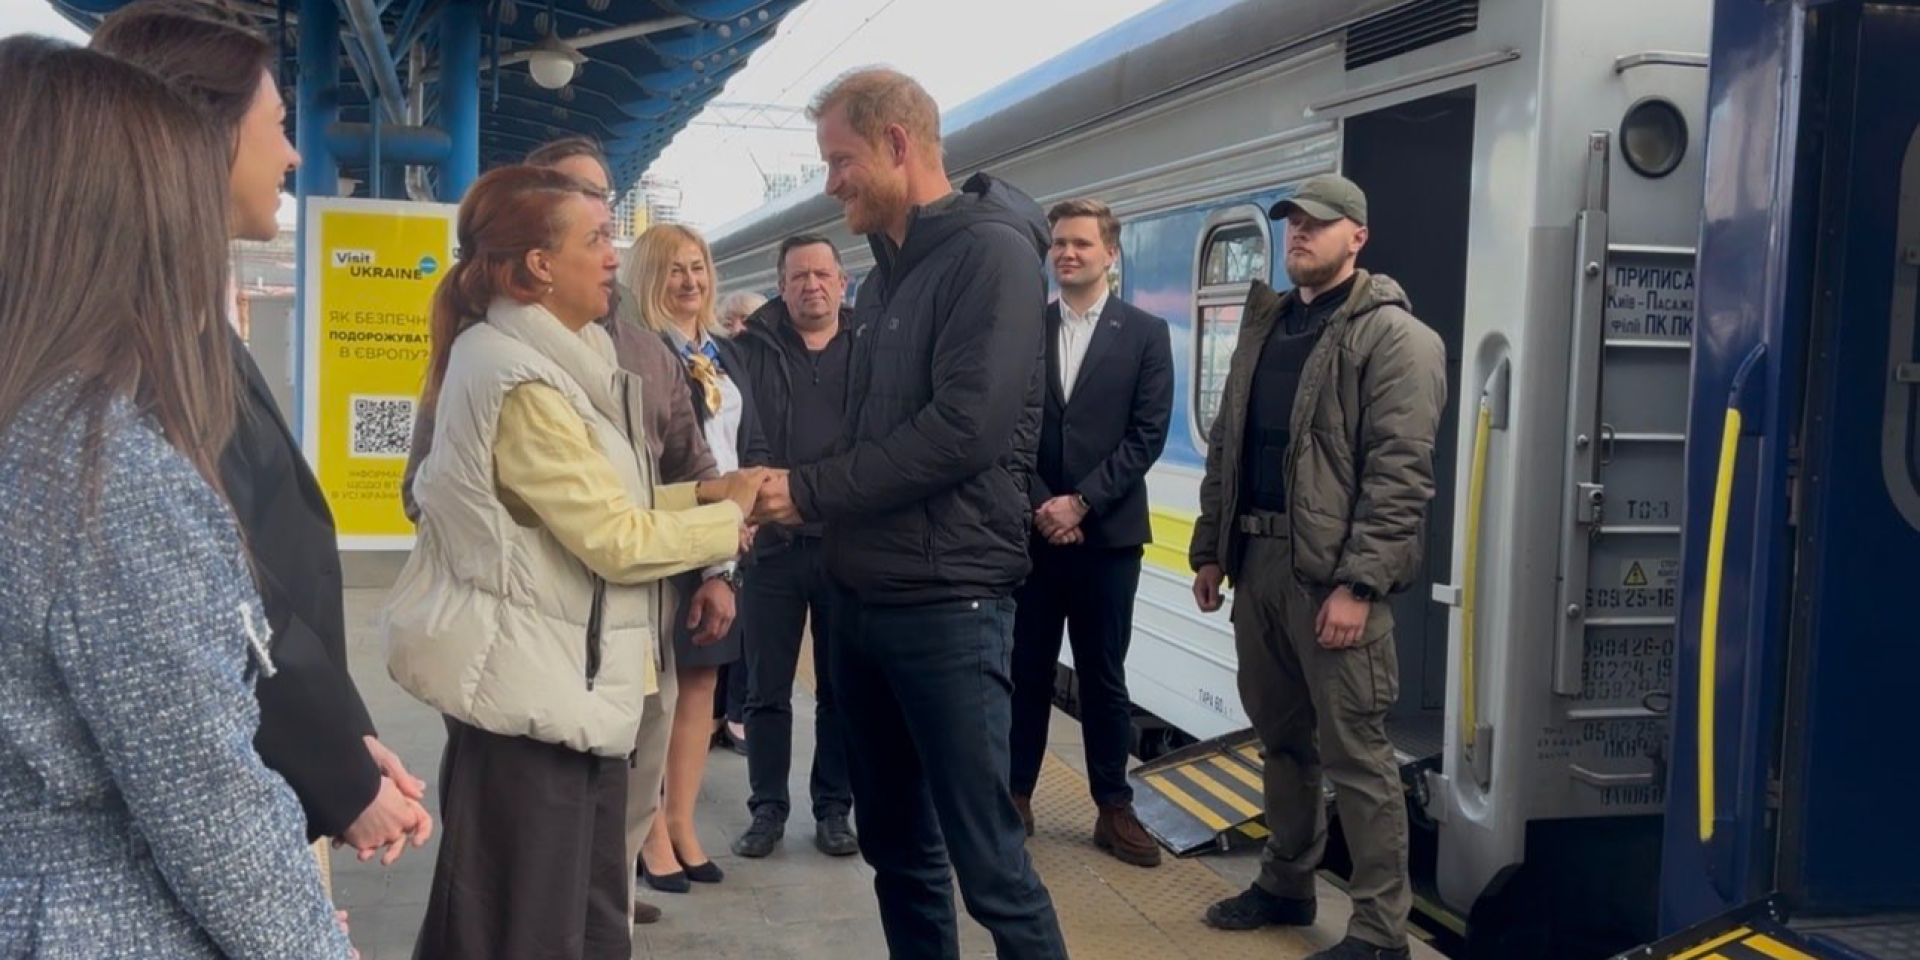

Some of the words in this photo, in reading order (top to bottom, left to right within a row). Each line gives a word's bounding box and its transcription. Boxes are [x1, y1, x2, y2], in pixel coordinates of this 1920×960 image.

[336, 252, 371, 264] Visit
[350, 265, 423, 281] UKRAINE
[329, 310, 349, 321] ЯК
[1645, 314, 1667, 335] ПК
[340, 346, 350, 358] В
[355, 347, 428, 361] ЄВРОПУ?
